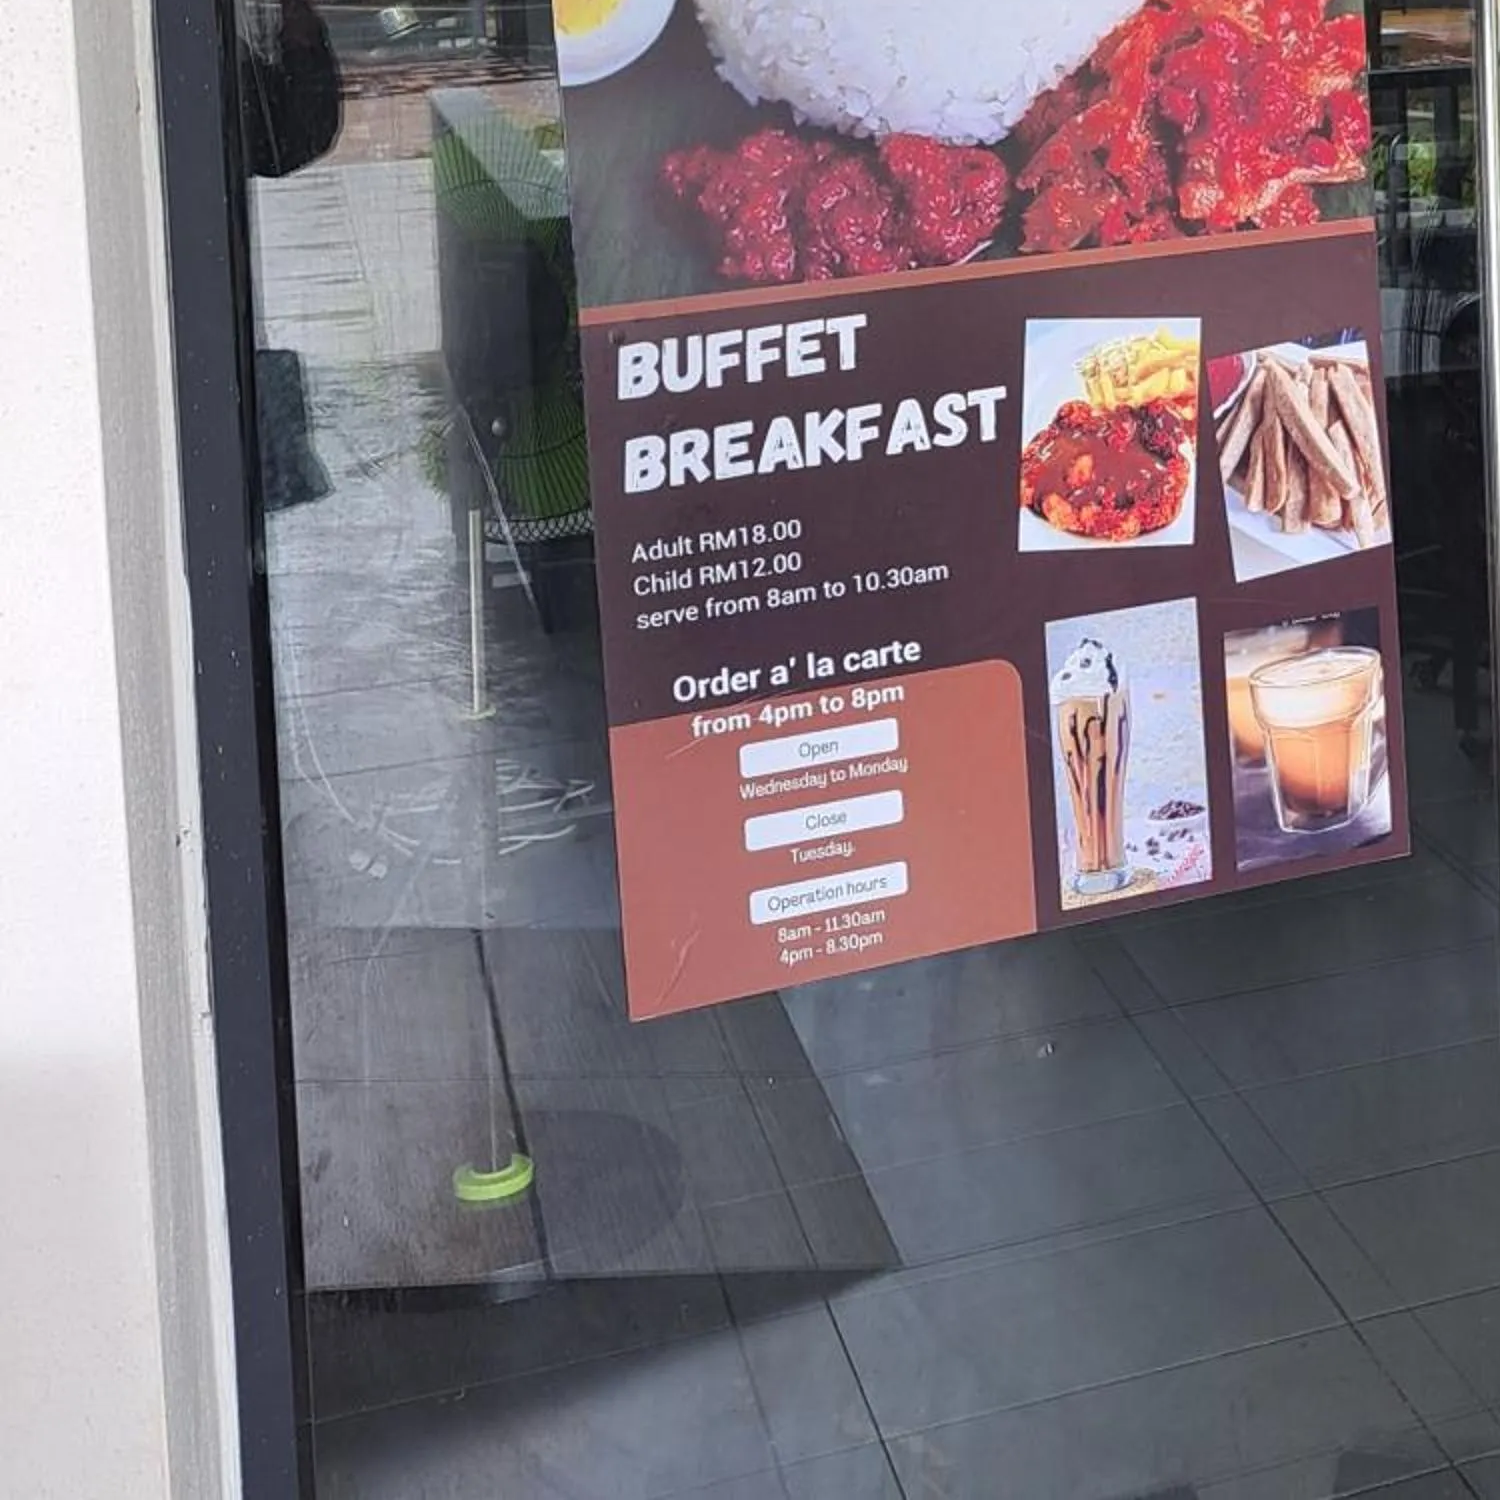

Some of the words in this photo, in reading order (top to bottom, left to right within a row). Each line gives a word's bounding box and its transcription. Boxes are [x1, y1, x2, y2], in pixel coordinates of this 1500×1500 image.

[617, 313, 868, 401] BUFFET
[624, 385, 1008, 494] BREAKFAST
[631, 536, 694, 564] Adult
[699, 519, 802, 553] RM18.00
[633, 568, 693, 597] Child
[699, 551, 802, 587] RM12.00
[636, 604, 700, 630] serve
[705, 596, 760, 619] from
[767, 586, 817, 609] 8am
[823, 580, 846, 599] to
[853, 563, 950, 594] 10.30am
[673, 665, 762, 703] Order
[807, 652, 835, 680] la
[843, 639, 922, 674] carte
[691, 714, 751, 739] from
[758, 702, 813, 728] 4pm
[820, 694, 845, 715] to
[852, 683, 904, 713] 8pm
[798, 739, 839, 761] Open
[739, 771, 828, 800] Wednesday
[830, 768, 847, 783] to
[849, 756, 909, 780] Monday
[804, 809, 848, 831] Close
[790, 838, 853, 865] Tuesday
[767, 880, 844, 915] Operation
[846, 875, 888, 896] hours
[778, 925, 811, 944] 8am
[779, 947, 814, 968] 4pm
